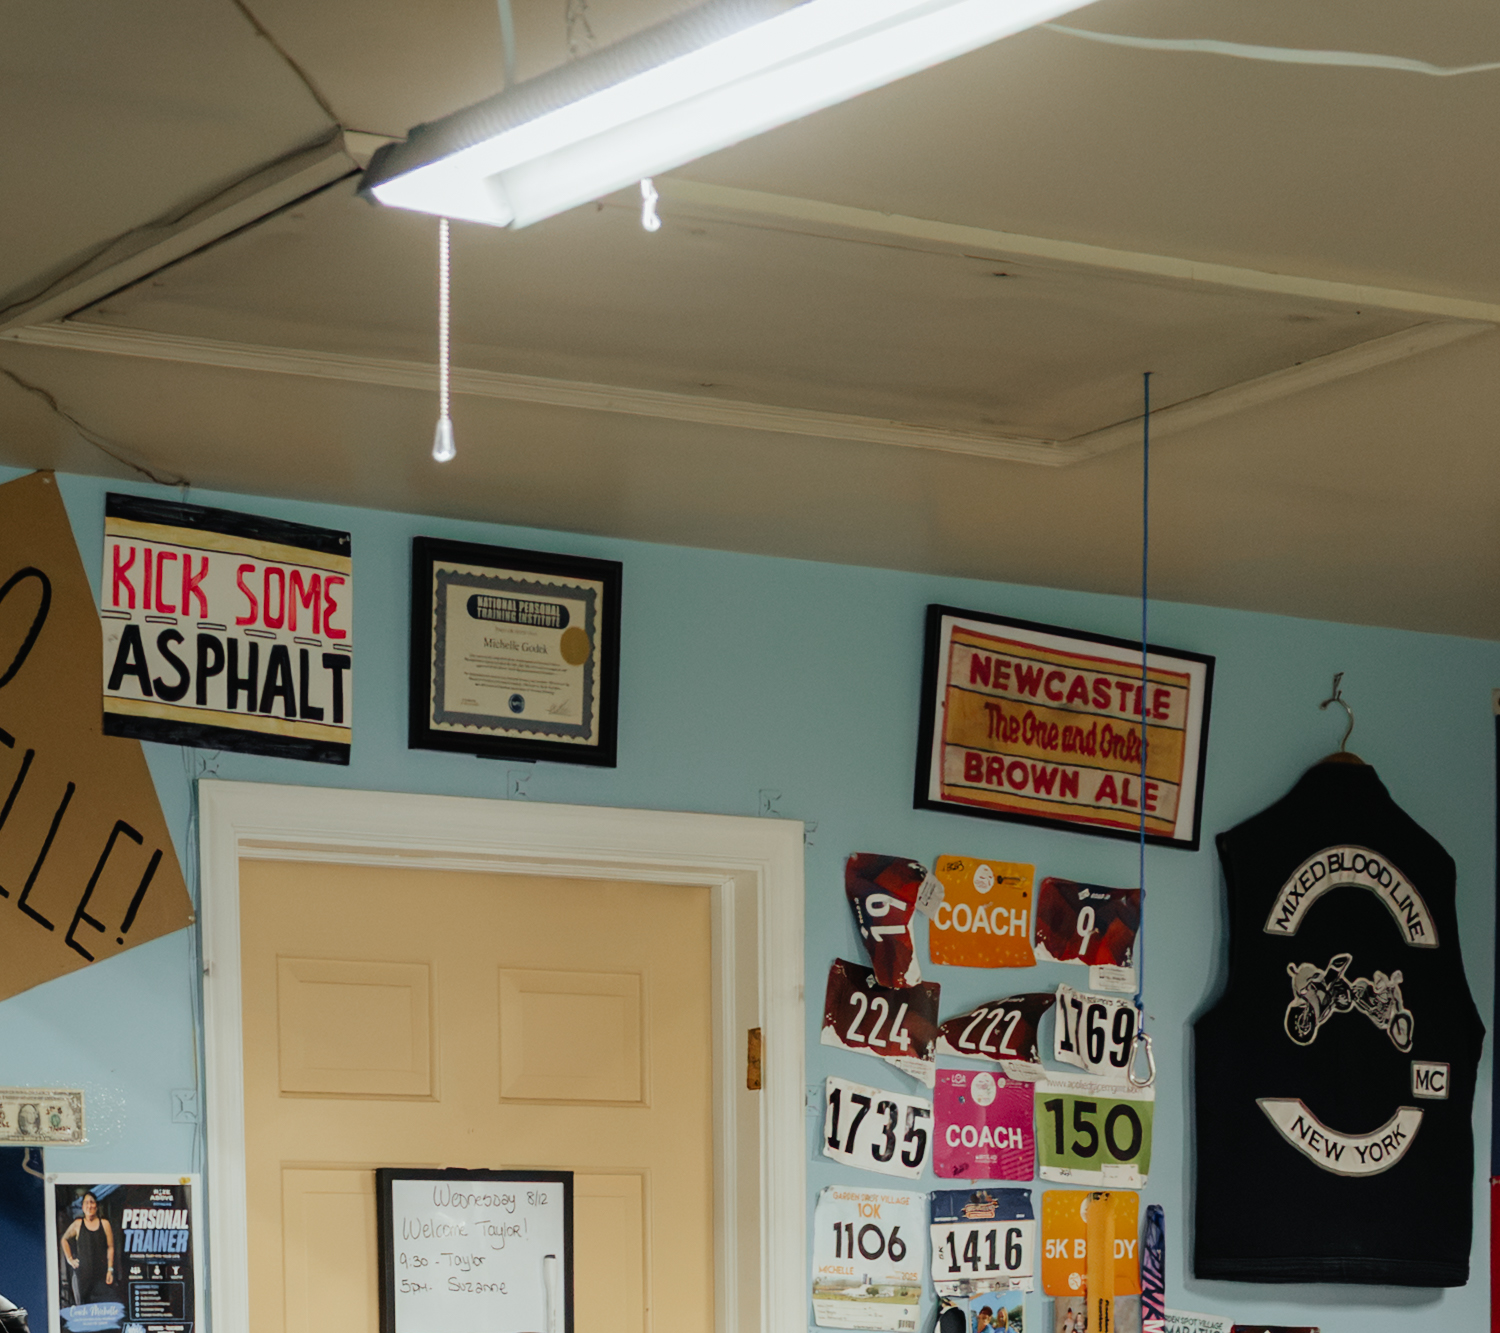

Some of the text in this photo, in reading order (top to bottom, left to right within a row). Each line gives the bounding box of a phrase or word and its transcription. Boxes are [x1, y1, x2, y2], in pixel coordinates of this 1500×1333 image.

[111, 544, 347, 641] KICK SOME
[476, 595, 560, 617] NATIONAL PERSONAL
[483, 637, 520, 651] Michelle
[106, 623, 350, 725] ASPHALT
[969, 653, 1171, 721] NEWCASTLE
[984, 702, 1021, 744] The
[1021, 710, 1059, 752] One
[1061, 720, 1097, 759] and
[963, 751, 1159, 812] BROWN ALE
[1274, 851, 1426, 942] MIXED BLOOD LINE
[933, 901, 1027, 937] COACH
[1077, 906, 1096, 956] 9
[846, 992, 911, 1051] 224
[958, 1008, 1022, 1056] 222
[1415, 1069, 1445, 1093] MC
[827, 1088, 931, 1168] 1735
[945, 1124, 1023, 1150] COACH
[1043, 1098, 1143, 1162] 150
[1290, 1116, 1407, 1165] NEW YORK
[858, 1203, 881, 1219] 10K
[881, 1195, 911, 1206] VILLAGE
[121, 1208, 189, 1230] PERSONAL
[402, 1217, 469, 1241] Welcome
[123, 1229, 189, 1253] TRAINER
[833, 1221, 907, 1262] 1106
[946, 1227, 1023, 1273] 1416
[1045, 1239, 1137, 1259] 5K BDY
[399, 1253, 430, 1269] 9:30
[818, 1265, 854, 1275] MICHELLE
[447, 1277, 509, 1296] Suzanne
[1199, 1319, 1224, 1330] VILLAGE
